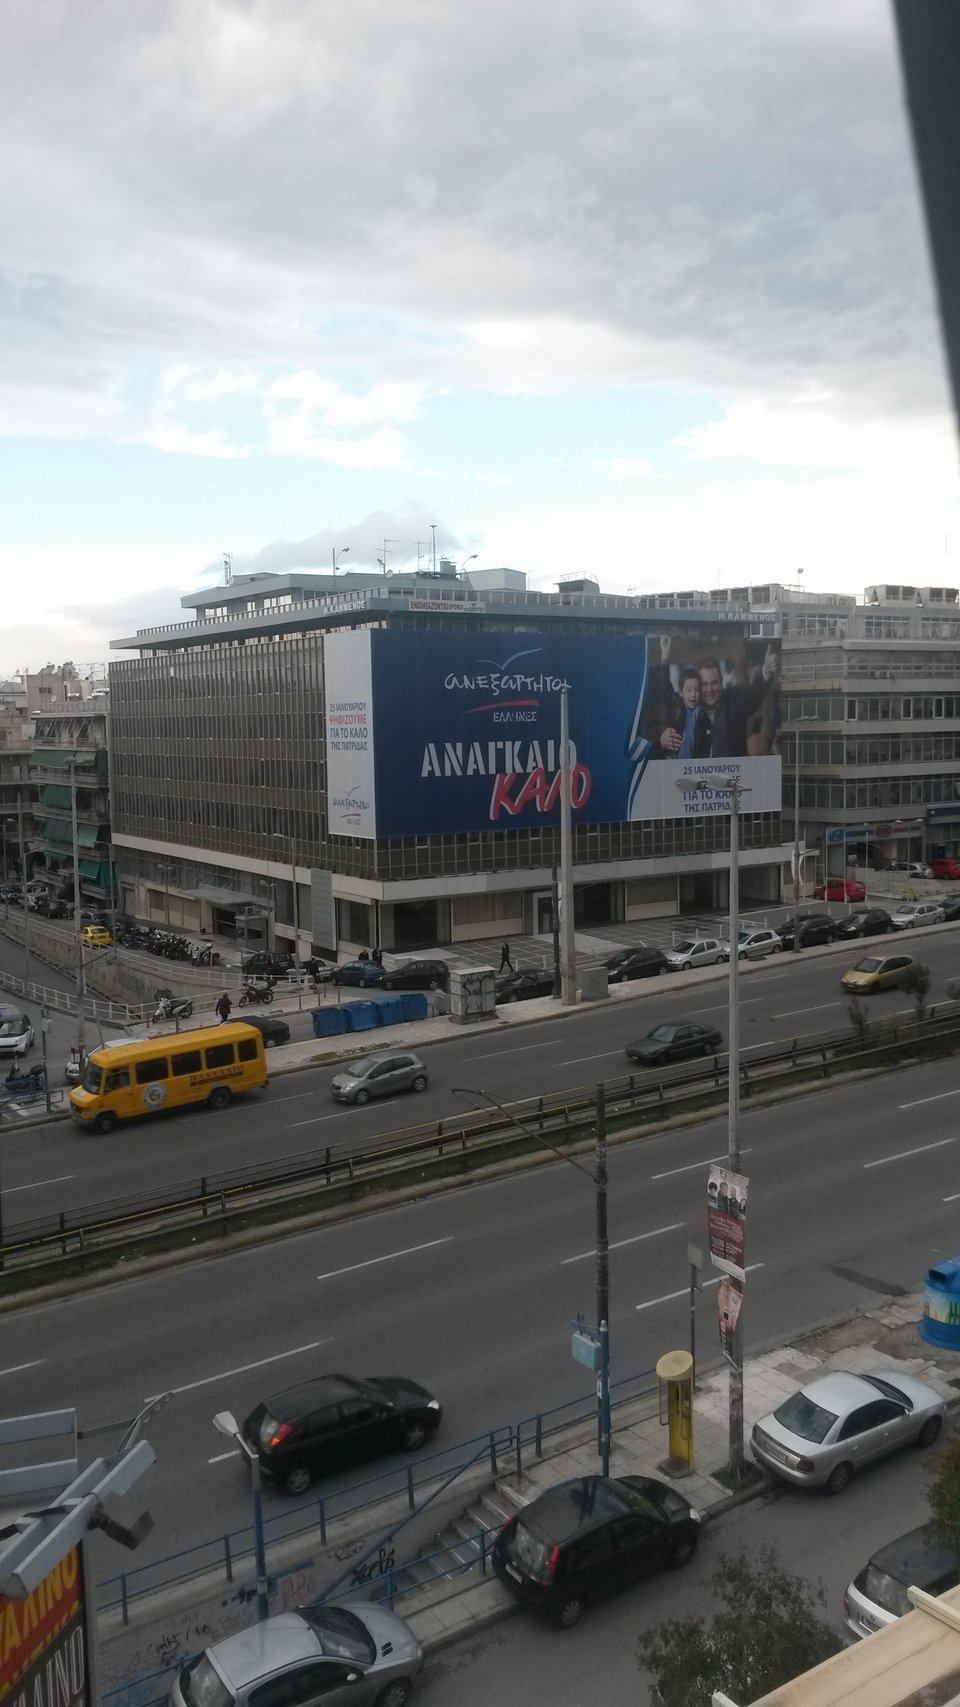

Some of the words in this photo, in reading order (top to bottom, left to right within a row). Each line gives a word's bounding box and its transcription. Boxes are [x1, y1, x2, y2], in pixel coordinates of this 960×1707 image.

[493, 711, 537, 723] ΕΛΛΗΝΕΣ
[340, 727, 349, 738] ΤΟ
[349, 727, 368, 738] ΚΑΛΟ
[683, 766, 693, 775] 25
[694, 764, 741, 774] ΙΑΝΟΥΑΡΙΟΥ
[700, 790, 713, 800] ΤΟ
[684, 803, 700, 813] ΤΗΣ
[702, 801, 741, 812] ΠΑΤΡΙΔΣ
